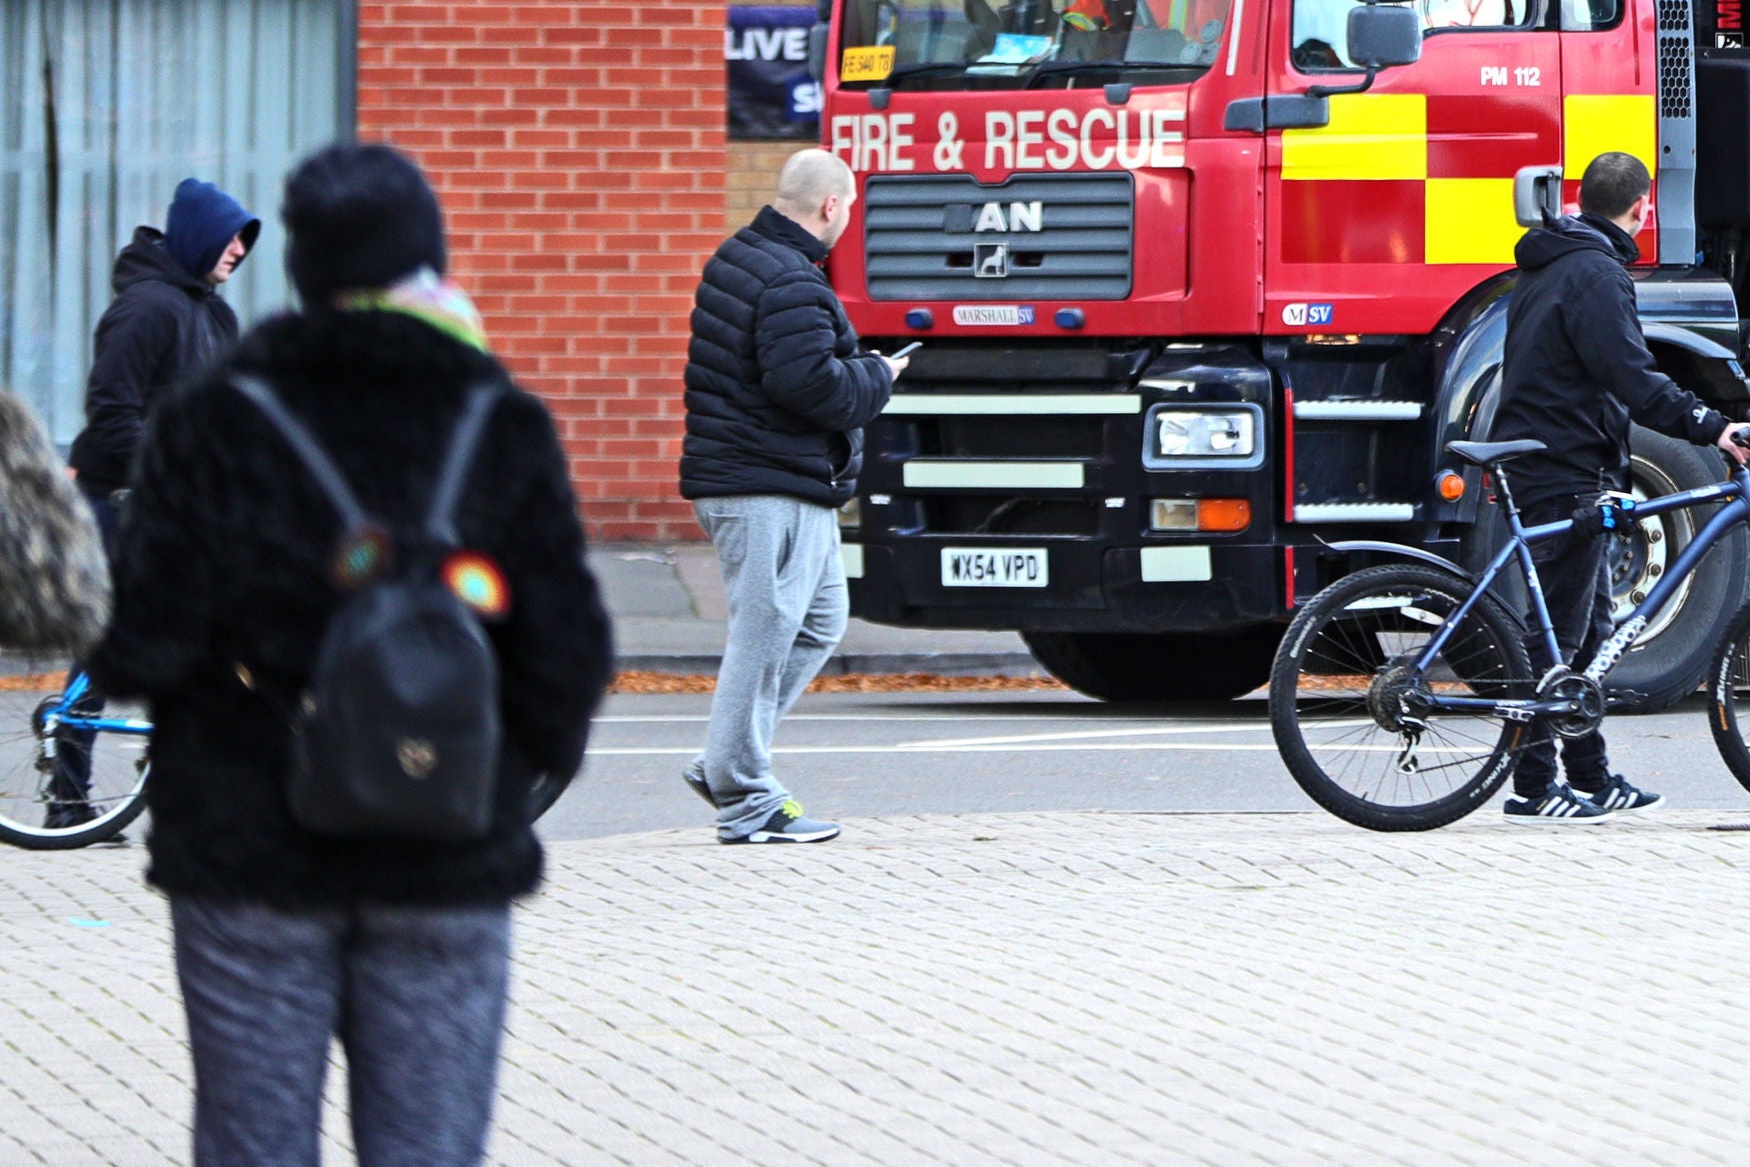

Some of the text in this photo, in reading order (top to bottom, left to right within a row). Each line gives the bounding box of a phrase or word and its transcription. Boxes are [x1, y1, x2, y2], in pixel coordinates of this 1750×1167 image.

[724, 27, 807, 60] LIVE
[1480, 66, 1541, 86] PM 112
[831, 109, 1187, 172] FIRE & RESCUE
[957, 308, 1016, 323] MARSHALL
[1288, 305, 1332, 323] M SV
[951, 554, 1038, 581] WX54 VPD
